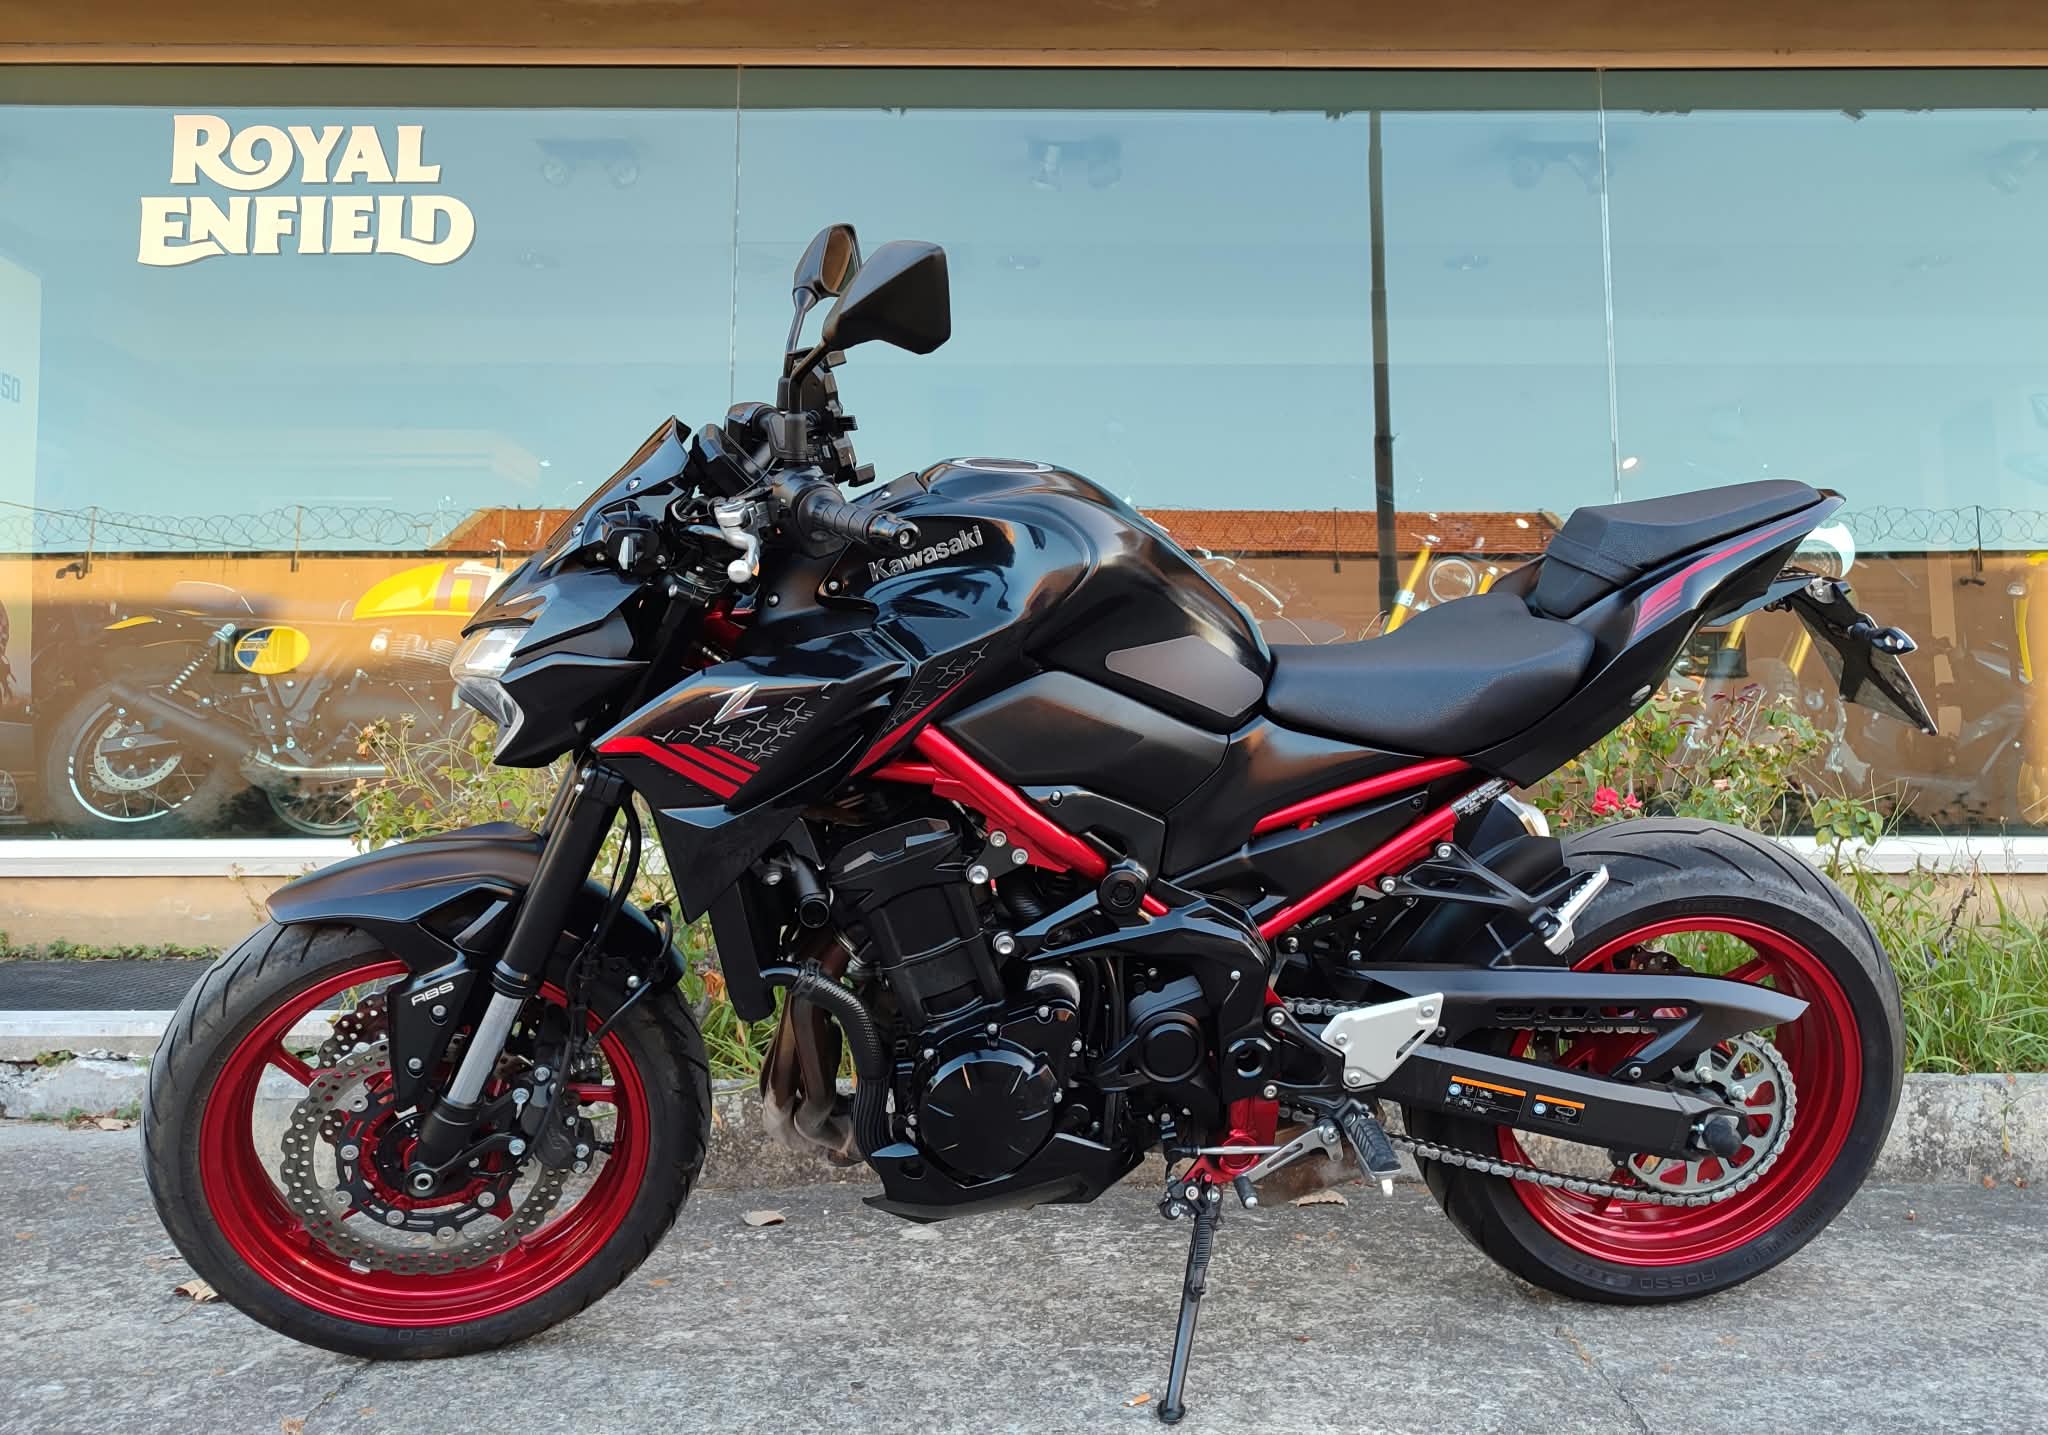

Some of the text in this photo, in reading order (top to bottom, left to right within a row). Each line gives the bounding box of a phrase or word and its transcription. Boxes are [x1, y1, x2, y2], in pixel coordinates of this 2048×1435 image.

[170, 114, 441, 191] ROYAL
[136, 195, 476, 267] ENFIELD
[868, 525, 984, 582] Kawasaki
[411, 981, 455, 1007] ABS
